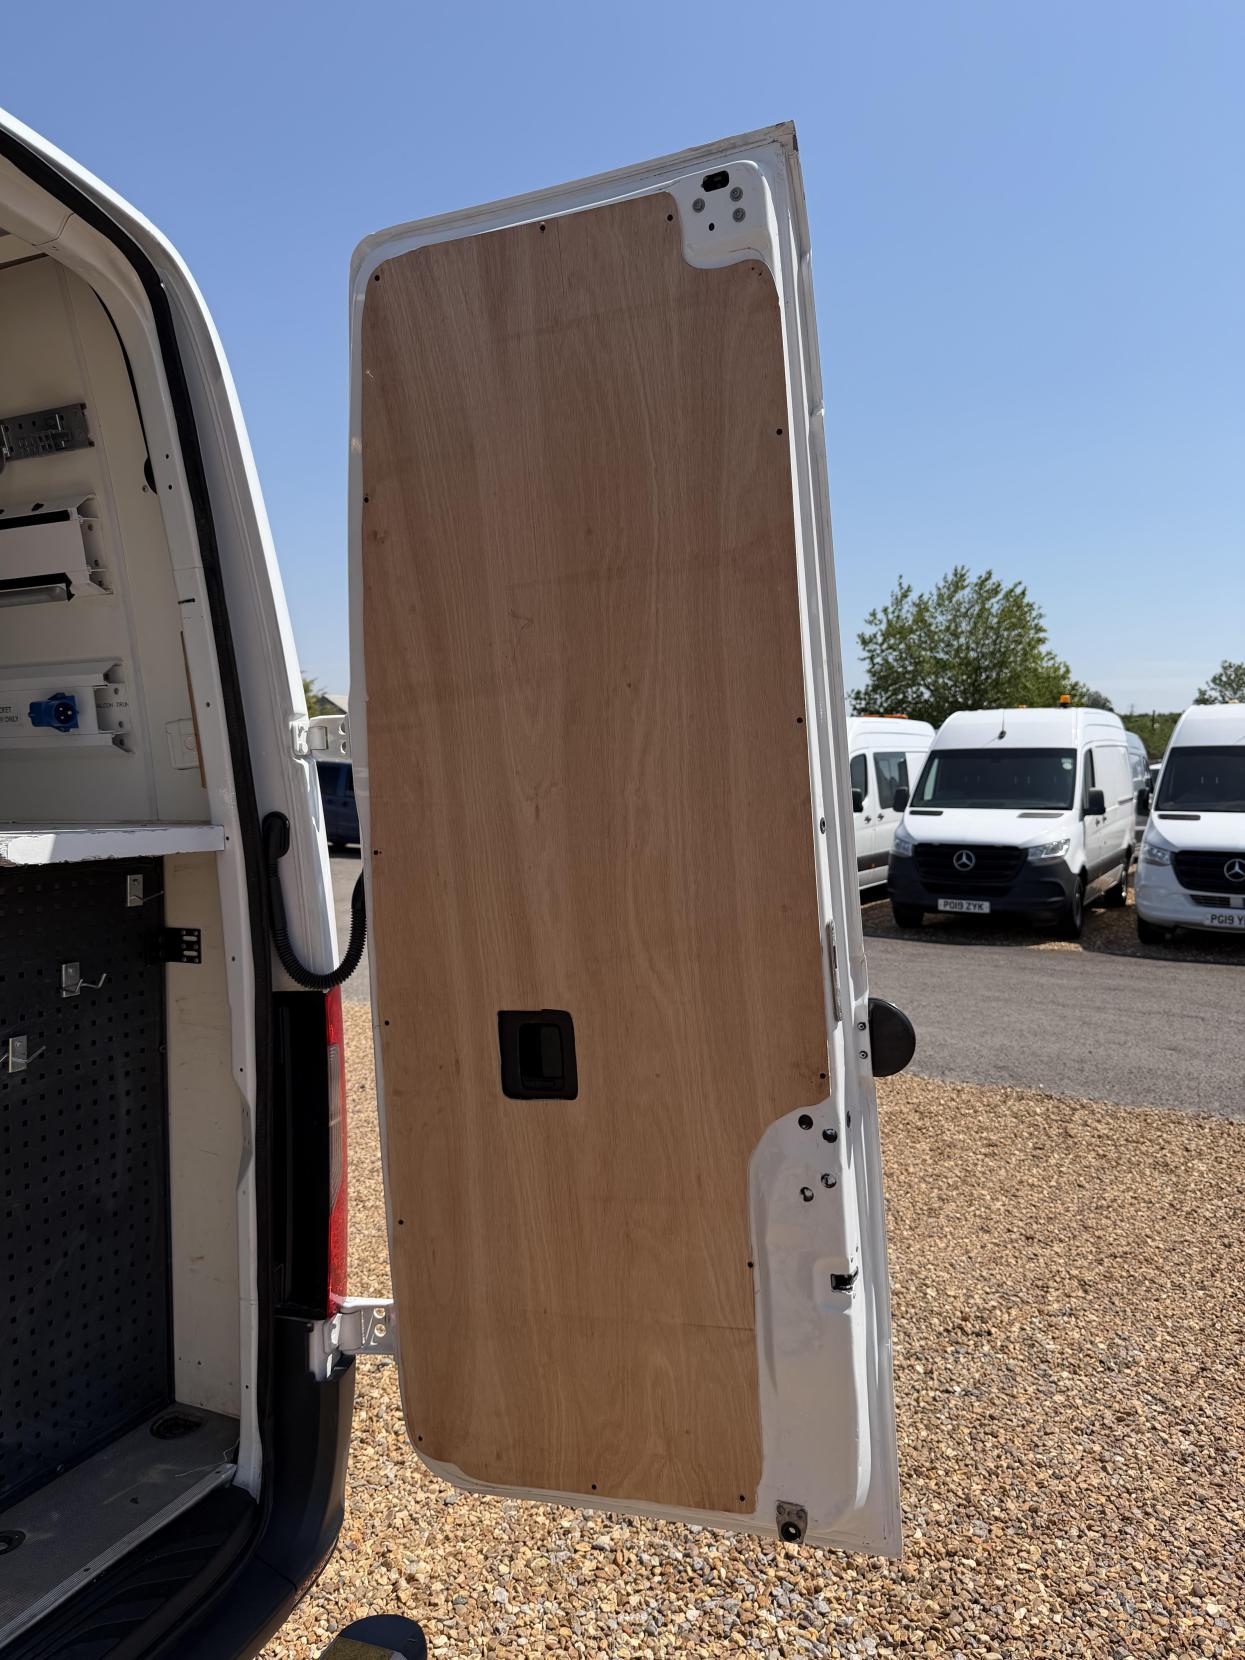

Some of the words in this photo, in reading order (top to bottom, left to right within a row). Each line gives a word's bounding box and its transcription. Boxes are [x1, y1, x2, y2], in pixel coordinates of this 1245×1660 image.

[943, 900, 964, 910] PO19
[965, 901, 985, 911] ZYK
[1210, 914, 1234, 925] PG19
[1236, 915, 1245, 926] Y
